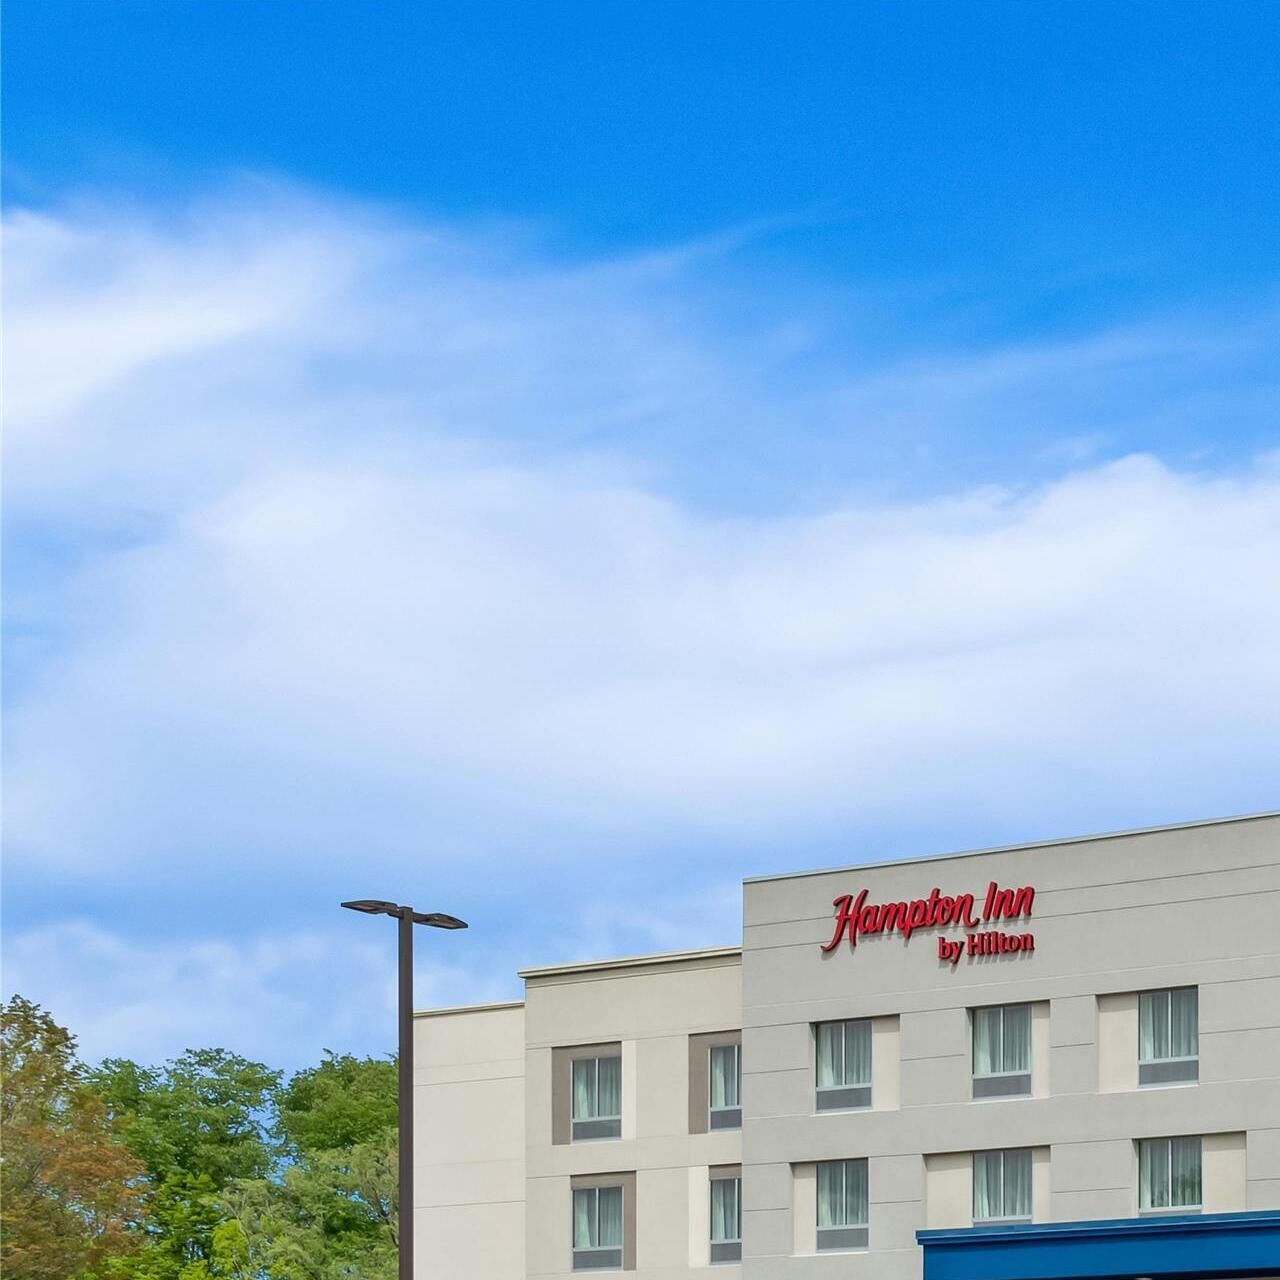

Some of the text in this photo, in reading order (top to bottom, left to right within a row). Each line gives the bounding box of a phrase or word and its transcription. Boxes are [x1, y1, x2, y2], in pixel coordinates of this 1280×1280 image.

[820, 881, 1035, 952] Hampton Inn
[938, 931, 1035, 964] by Hilton
